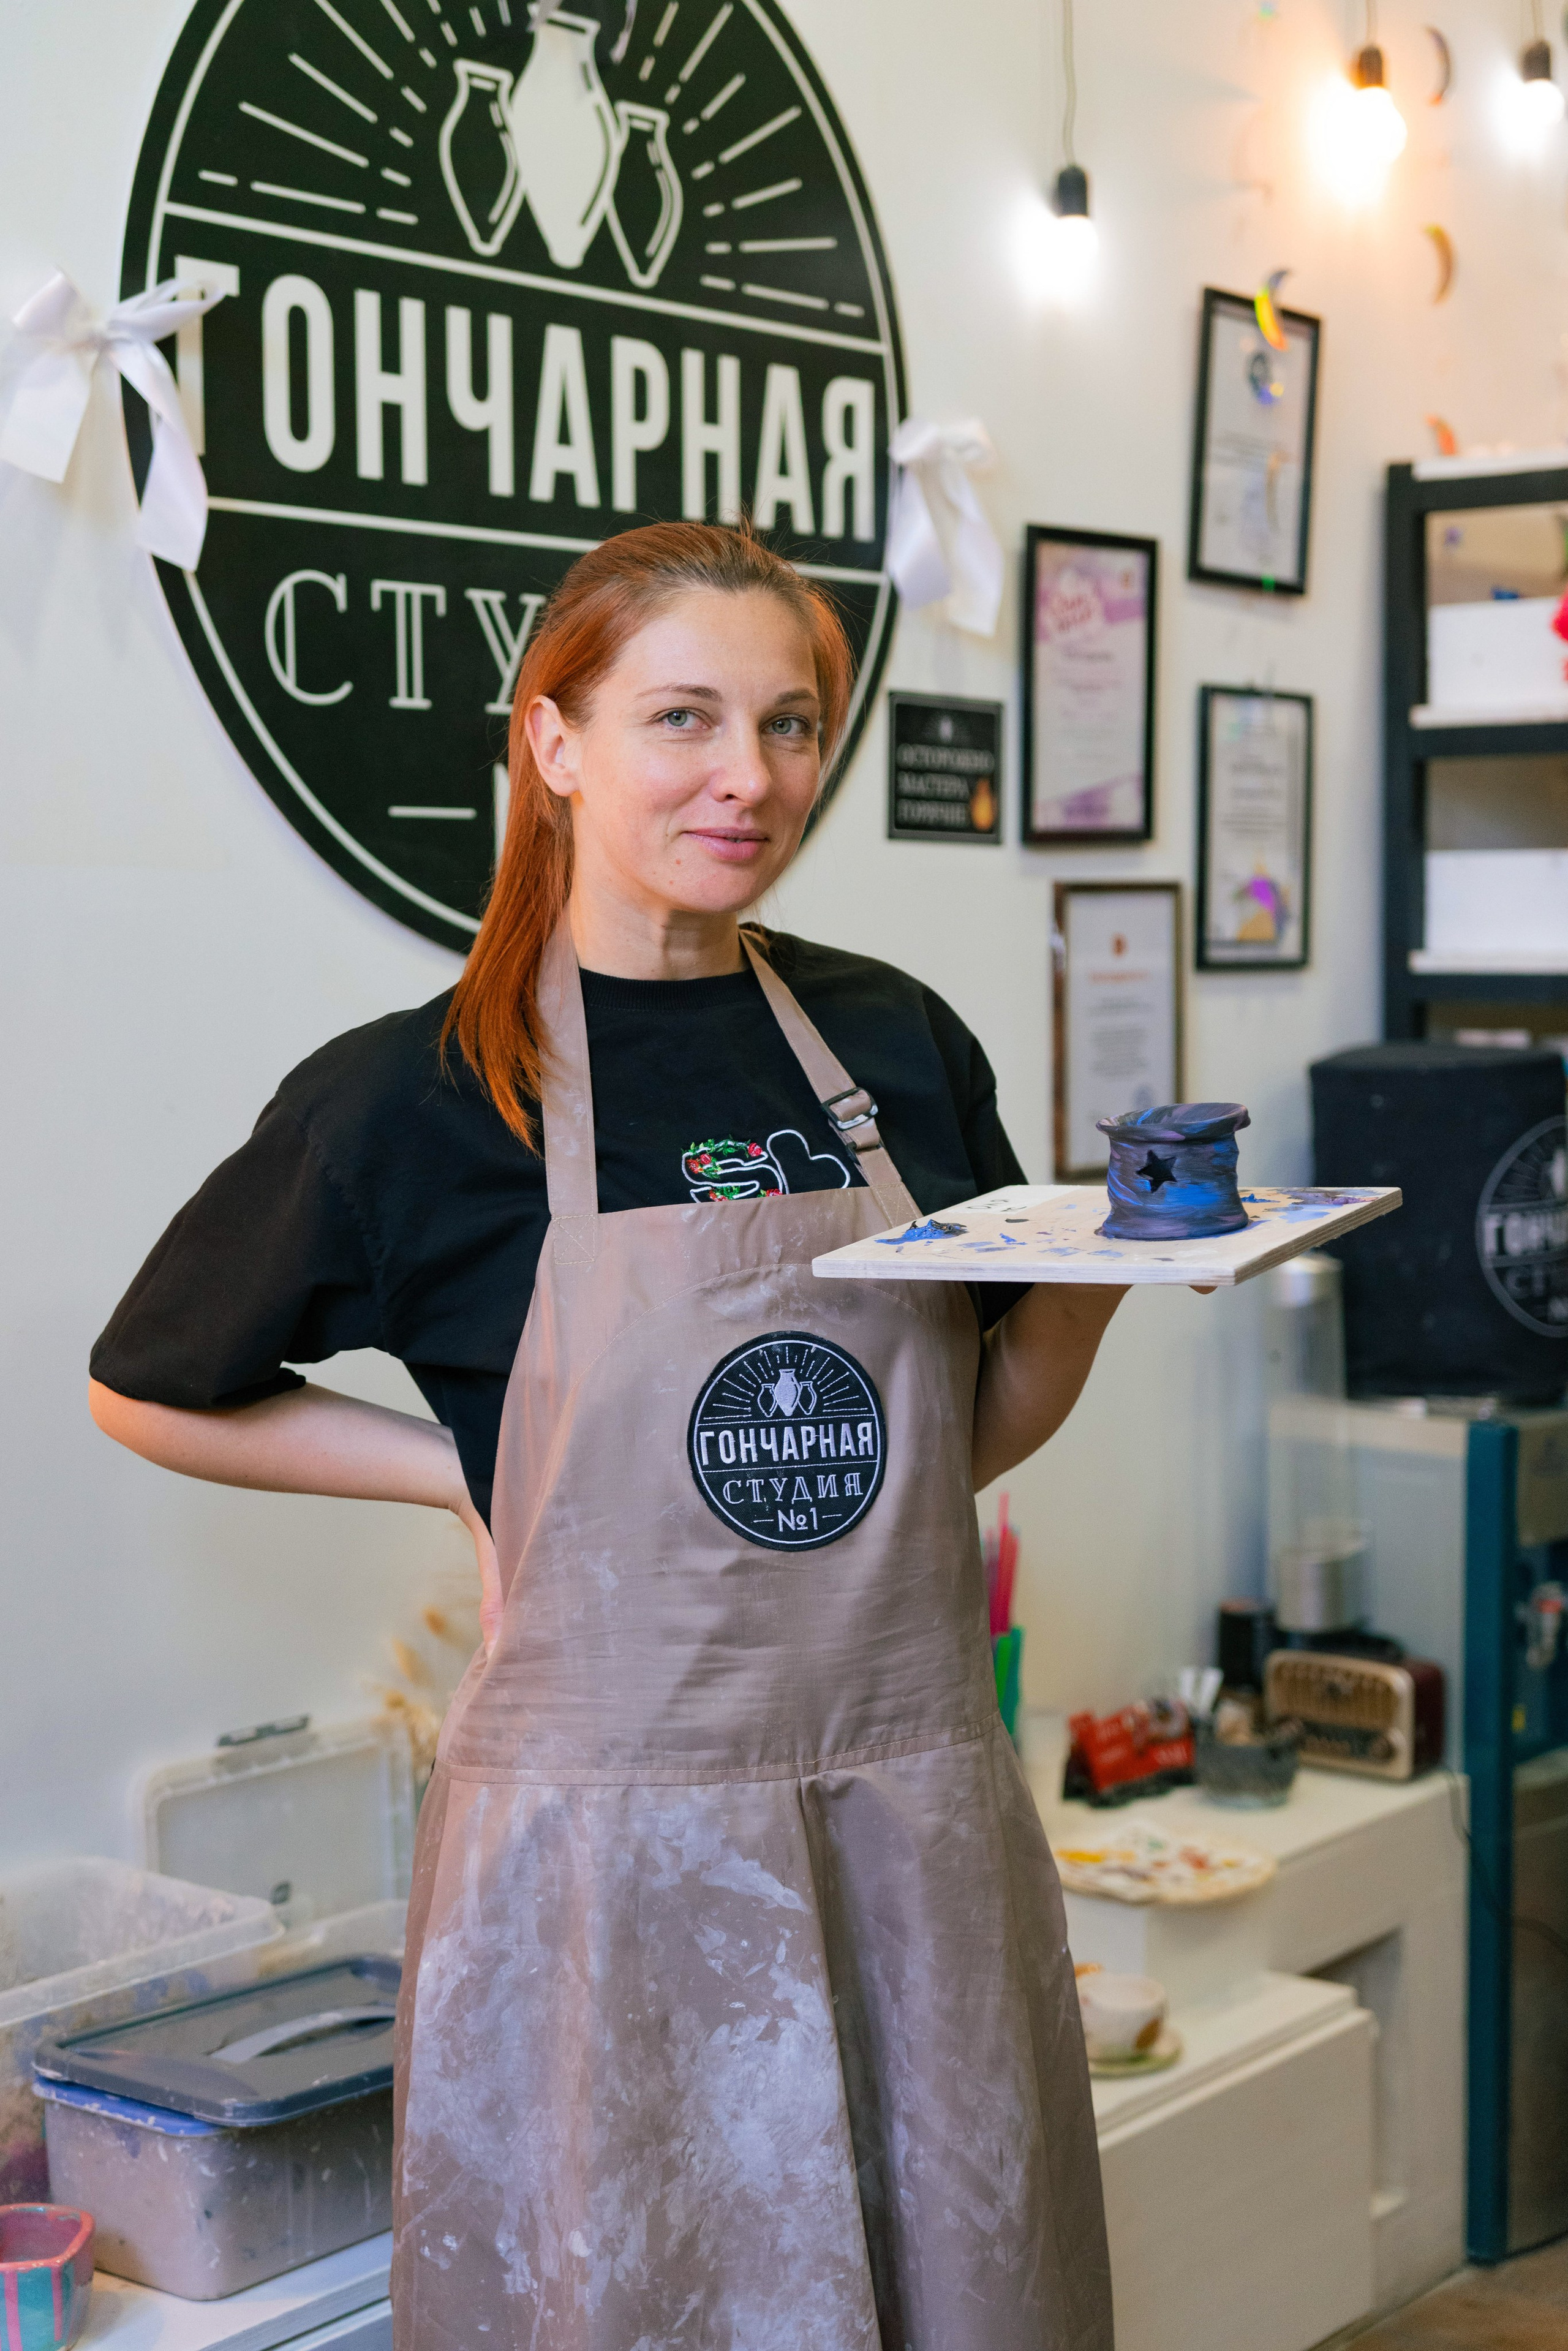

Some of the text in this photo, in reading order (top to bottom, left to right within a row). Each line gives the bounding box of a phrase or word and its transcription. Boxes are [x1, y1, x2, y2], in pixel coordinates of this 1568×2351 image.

[175, 254, 875, 542] ГОНЧАРНАЯ
[265, 569, 547, 715] СТУ
[699, 1422, 875, 1466] ГОНЧАРНАЯ
[722, 1472, 864, 1504] СТУДИЯ
[777, 1507, 818, 1531] №1
